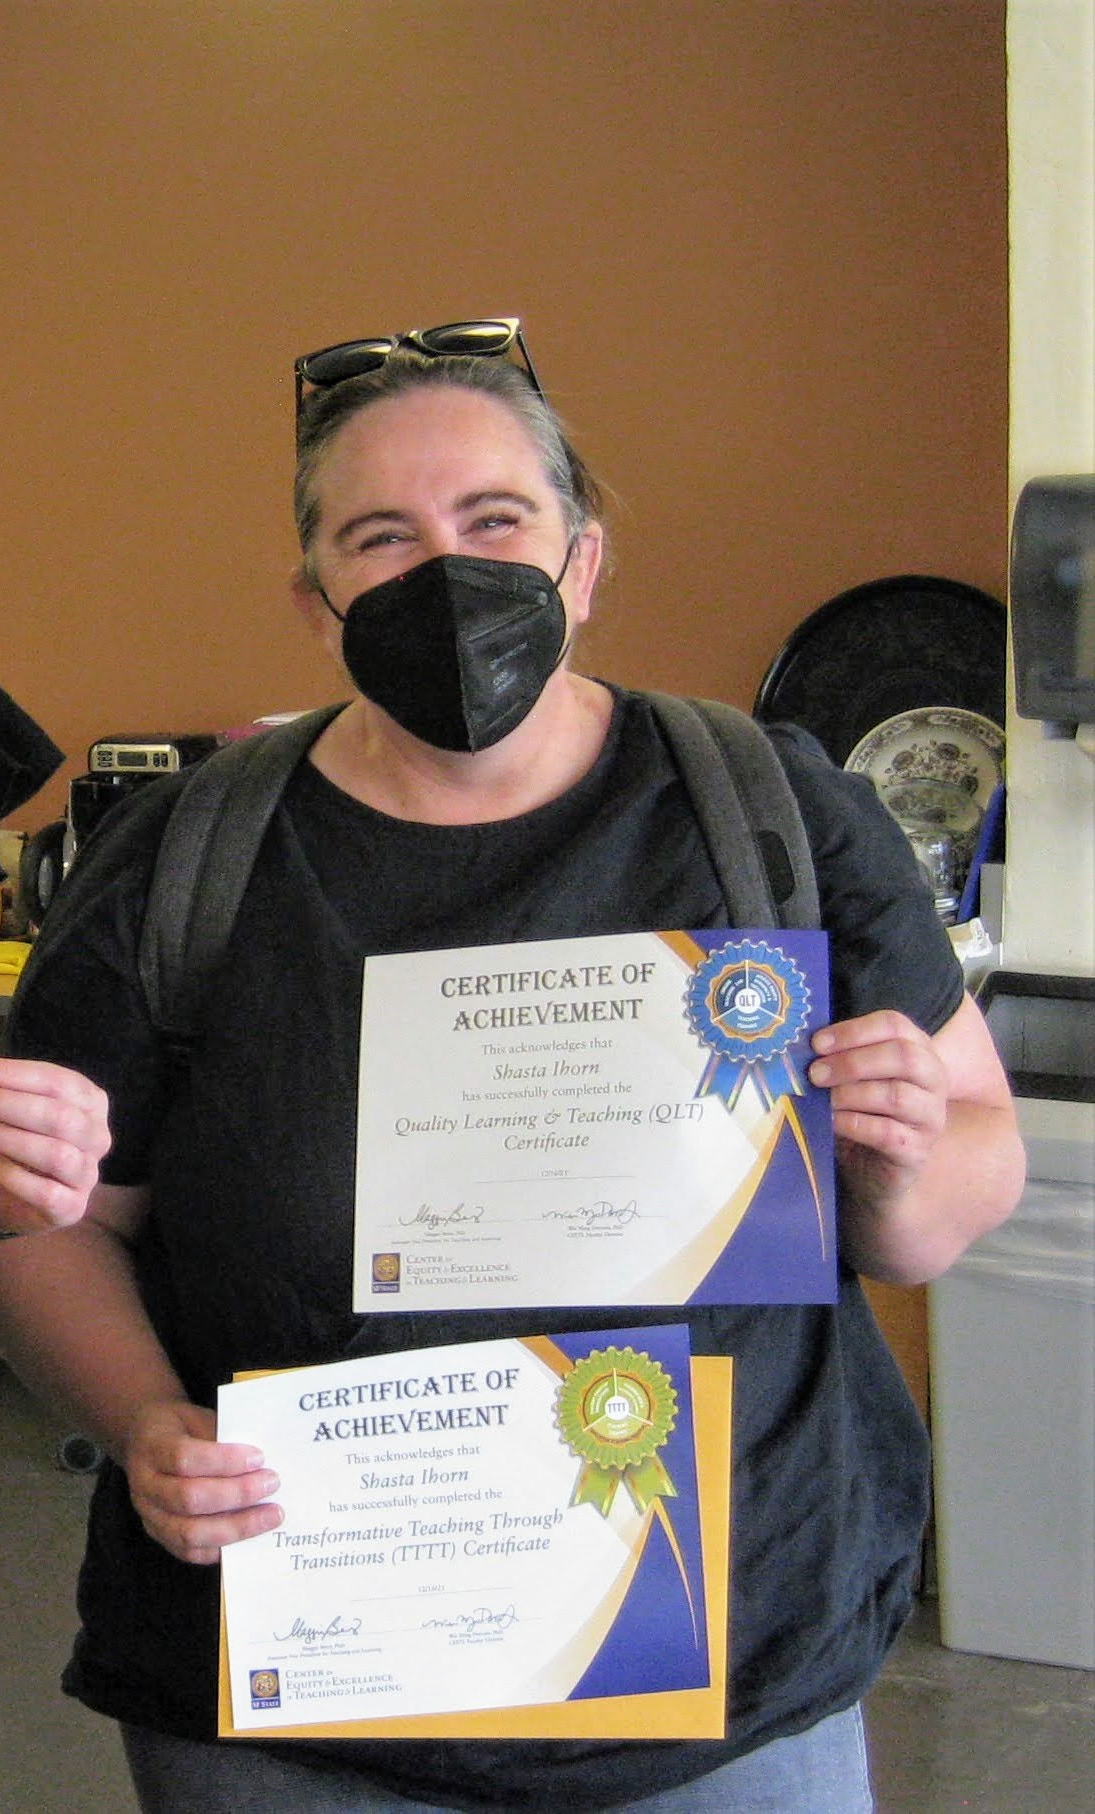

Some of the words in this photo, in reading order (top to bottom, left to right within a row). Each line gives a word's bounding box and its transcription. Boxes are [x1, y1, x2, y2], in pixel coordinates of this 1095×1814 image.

[440, 965, 613, 999] CERTIFICATE
[621, 962, 656, 985] OF
[739, 995, 756, 1007] QLT
[452, 998, 644, 1031] ACHIEVEMENT
[481, 1043, 506, 1056] This
[508, 1040, 587, 1055] acknowledges
[589, 1037, 613, 1049] that
[492, 1061, 547, 1081] Shasta
[552, 1059, 601, 1078] Ihorn
[462, 1089, 481, 1101] has
[484, 1084, 549, 1103] successfully
[551, 1082, 611, 1099] completed
[613, 1082, 632, 1094] the
[395, 1115, 458, 1137] Quality
[463, 1111, 538, 1135] Learning
[544, 1109, 562, 1127] &
[567, 1106, 643, 1126] Teaching
[648, 1102, 704, 1124] (QLT)
[503, 1132, 590, 1152] Certificate
[298, 1372, 477, 1412] CERTIFICATE
[485, 1368, 520, 1391] OF
[313, 1404, 509, 1443] ACHIEVEMENT
[345, 1452, 371, 1465] This
[373, 1447, 453, 1464] acknowledges
[456, 1443, 480, 1457] that
[359, 1469, 415, 1491] Shasta
[420, 1465, 469, 1486] Ihorn
[329, 1500, 349, 1513] has
[351, 1494, 419, 1513] successfully
[421, 1489, 481, 1506] completed
[483, 1487, 503, 1500] the
[272, 1520, 403, 1550] Transformative
[407, 1513, 484, 1539] Teaching
[490, 1509, 563, 1533] Through
[289, 1548, 385, 1573] Transitions
[391, 1543, 457, 1567] (TTTT)
[462, 1534, 551, 1560] Certificate
